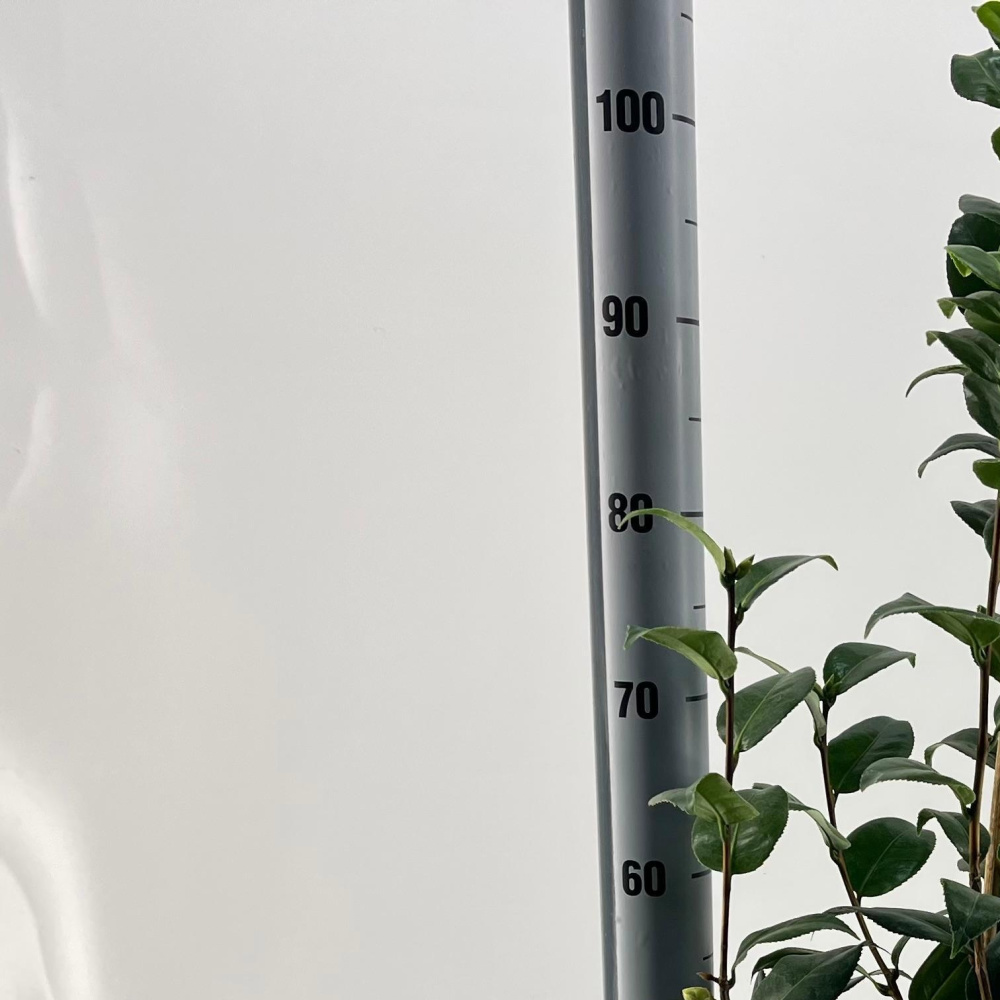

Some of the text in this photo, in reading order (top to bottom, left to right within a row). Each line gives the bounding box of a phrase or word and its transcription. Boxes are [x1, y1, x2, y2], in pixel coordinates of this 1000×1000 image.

[596, 88, 665, 135] 100
[602, 295, 648, 338] 90
[608, 493, 653, 534] 80
[614, 681, 659, 719] 70
[622, 860, 666, 897] 60
